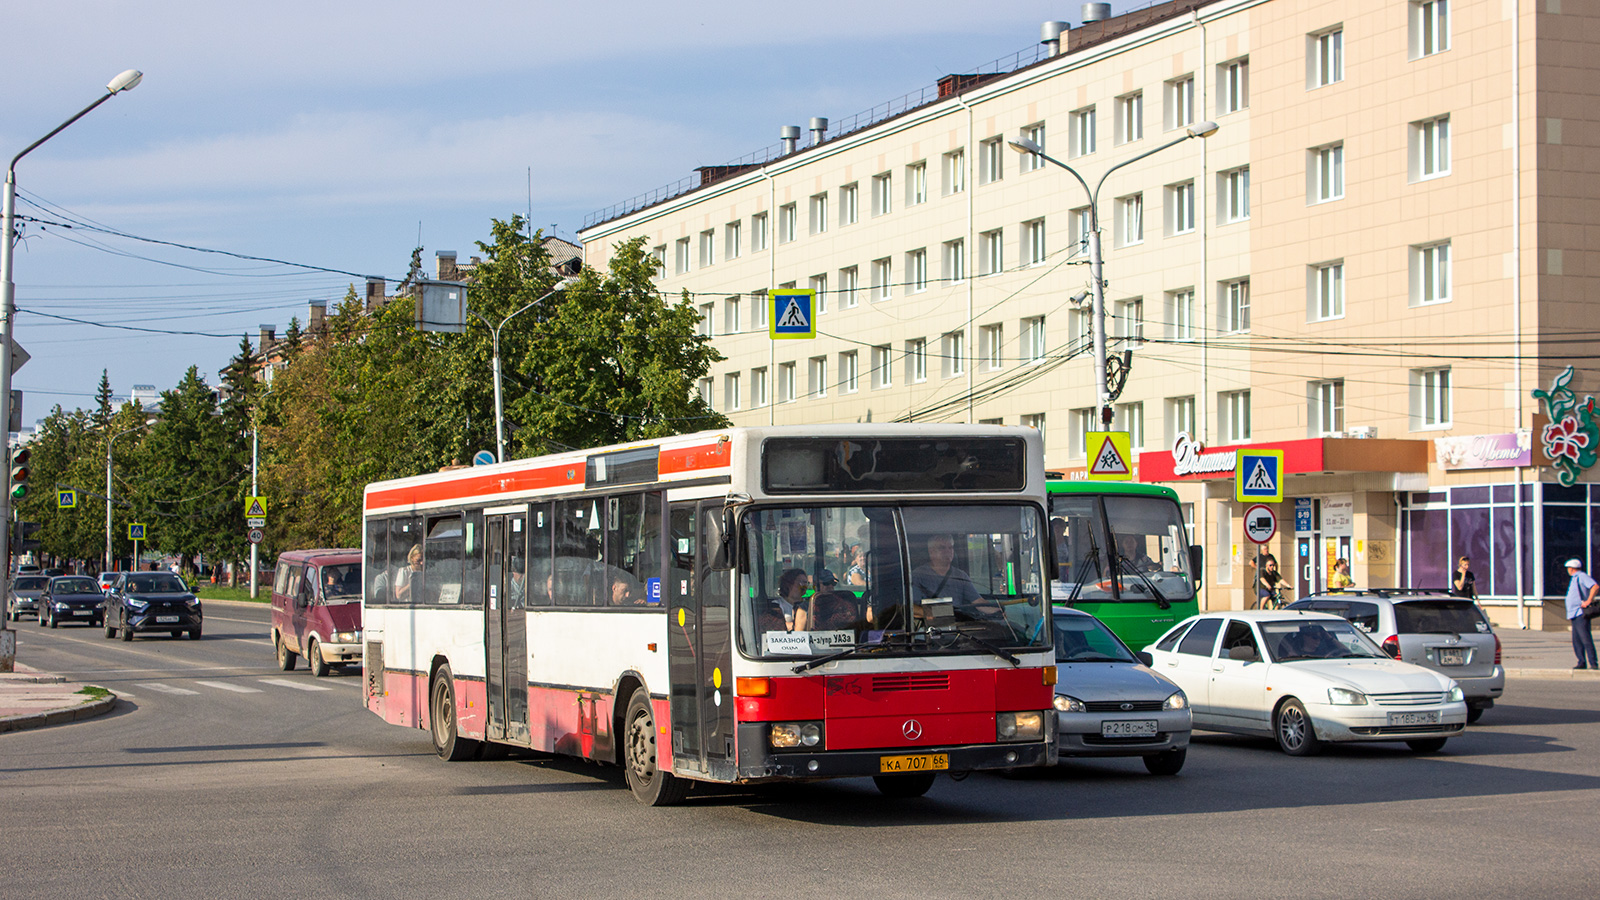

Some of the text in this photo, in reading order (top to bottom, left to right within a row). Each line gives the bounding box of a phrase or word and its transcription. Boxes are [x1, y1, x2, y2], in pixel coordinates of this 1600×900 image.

[1473, 436, 1523, 467] Цветы
[770, 636, 806, 644] ЗАКАЗНОЙ
[833, 633, 852, 643] УАЗа
[886, 755, 944, 770] КА 707 66
